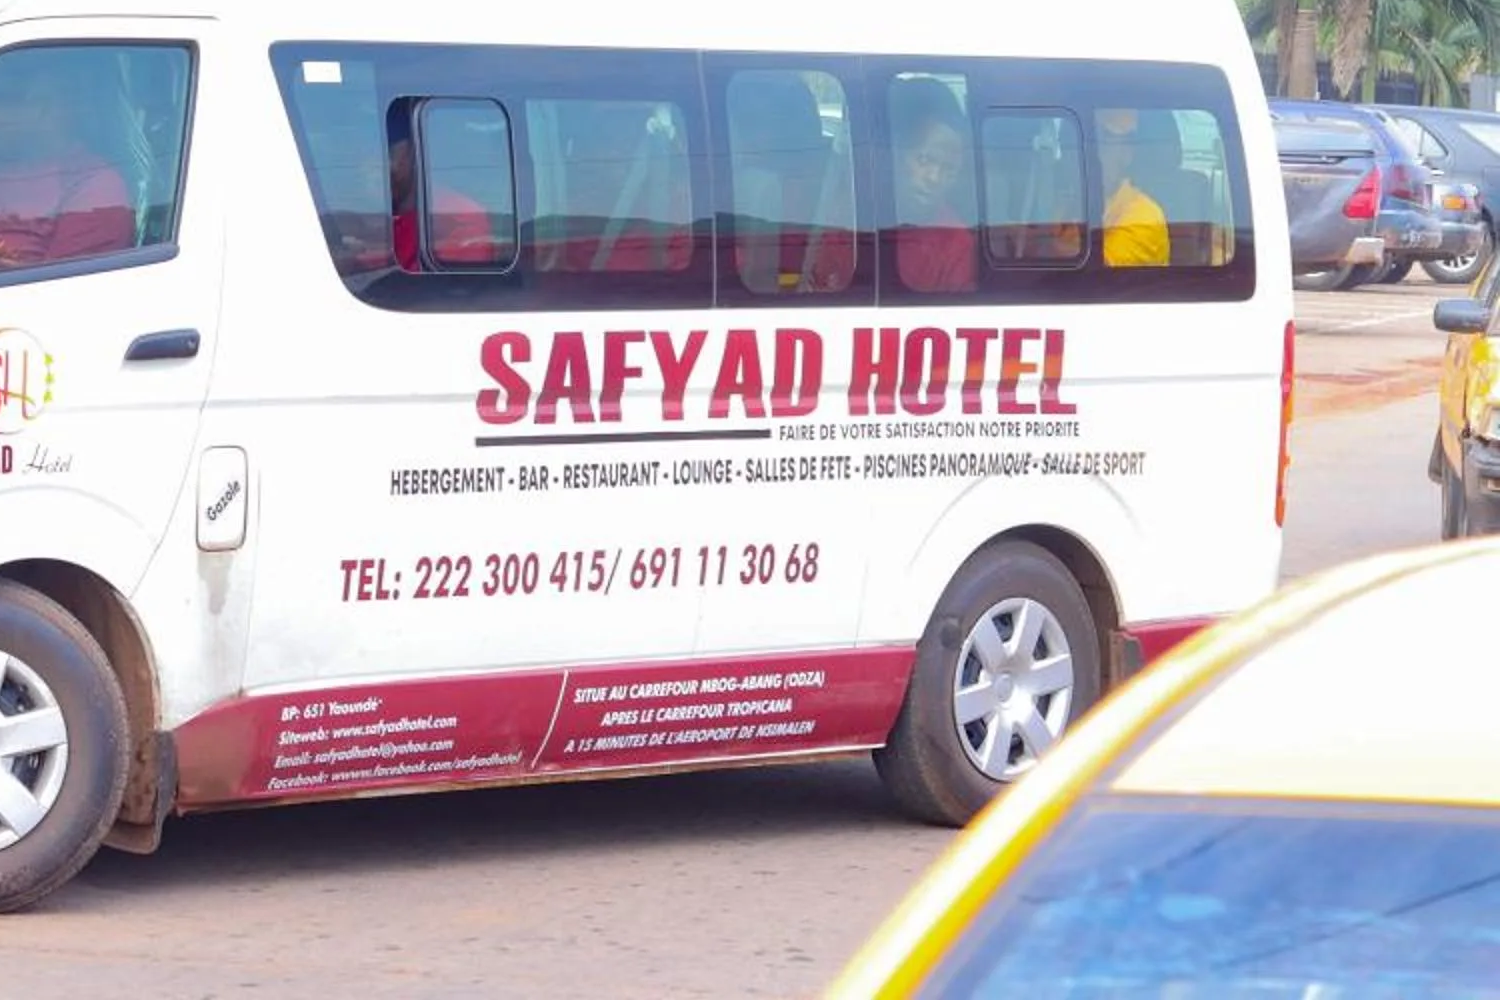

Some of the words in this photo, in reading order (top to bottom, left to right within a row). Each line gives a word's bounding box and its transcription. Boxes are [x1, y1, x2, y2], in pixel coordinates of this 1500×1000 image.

[476, 329, 823, 425] SAFYAD
[847, 327, 1077, 416] HOTEL
[779, 425, 815, 441] FAIRE
[819, 424, 837, 440] DE
[840, 424, 882, 440] VOTRE
[885, 422, 975, 438] SATISFACTION
[979, 422, 1021, 437] NOTRE
[1025, 421, 1080, 437] PRIORITE
[390, 467, 506, 495] HEBERGEMENT
[518, 466, 549, 491] BAR
[562, 462, 661, 489] RESTAURANT
[672, 459, 733, 485] LOUNGE
[745, 457, 796, 483] SALLES
[799, 457, 818, 481] DE
[820, 456, 852, 480] FETE
[863, 455, 927, 479] PISCINES
[929, 453, 1031, 478] PANORAMIQUE
[1041, 452, 1083, 475] SALLE
[1082, 452, 1101, 475] DE
[1103, 451, 1146, 475] SPORT
[206, 480, 241, 522] Gazole
[340, 559, 401, 601] TEL:
[413, 556, 472, 598] 222
[482, 552, 540, 596] 300
[629, 547, 681, 589] 691
[698, 546, 728, 585] 11
[739, 544, 776, 584] 30
[784, 542, 820, 583] 68
[574, 687, 608, 703] SITUE
[608, 685, 628, 700] AU
[629, 679, 699, 699] CARREFOUR
[700, 673, 782, 693] MBOG-ABANG
[783, 671, 825, 690] (ODZA)
[281, 706, 301, 721] BP:
[601, 709, 639, 726] APRES
[640, 709, 655, 724] LE
[656, 703, 725, 721] CARREFOUR
[727, 698, 793, 717] TROPICANA
[278, 728, 329, 746] Siteweb:
[333, 714, 458, 740] www.safyadhotel.com
[577, 737, 595, 752] 15
[593, 732, 647, 751] MINUTES
[648, 731, 666, 746] DE
[737, 724, 756, 740] DE
